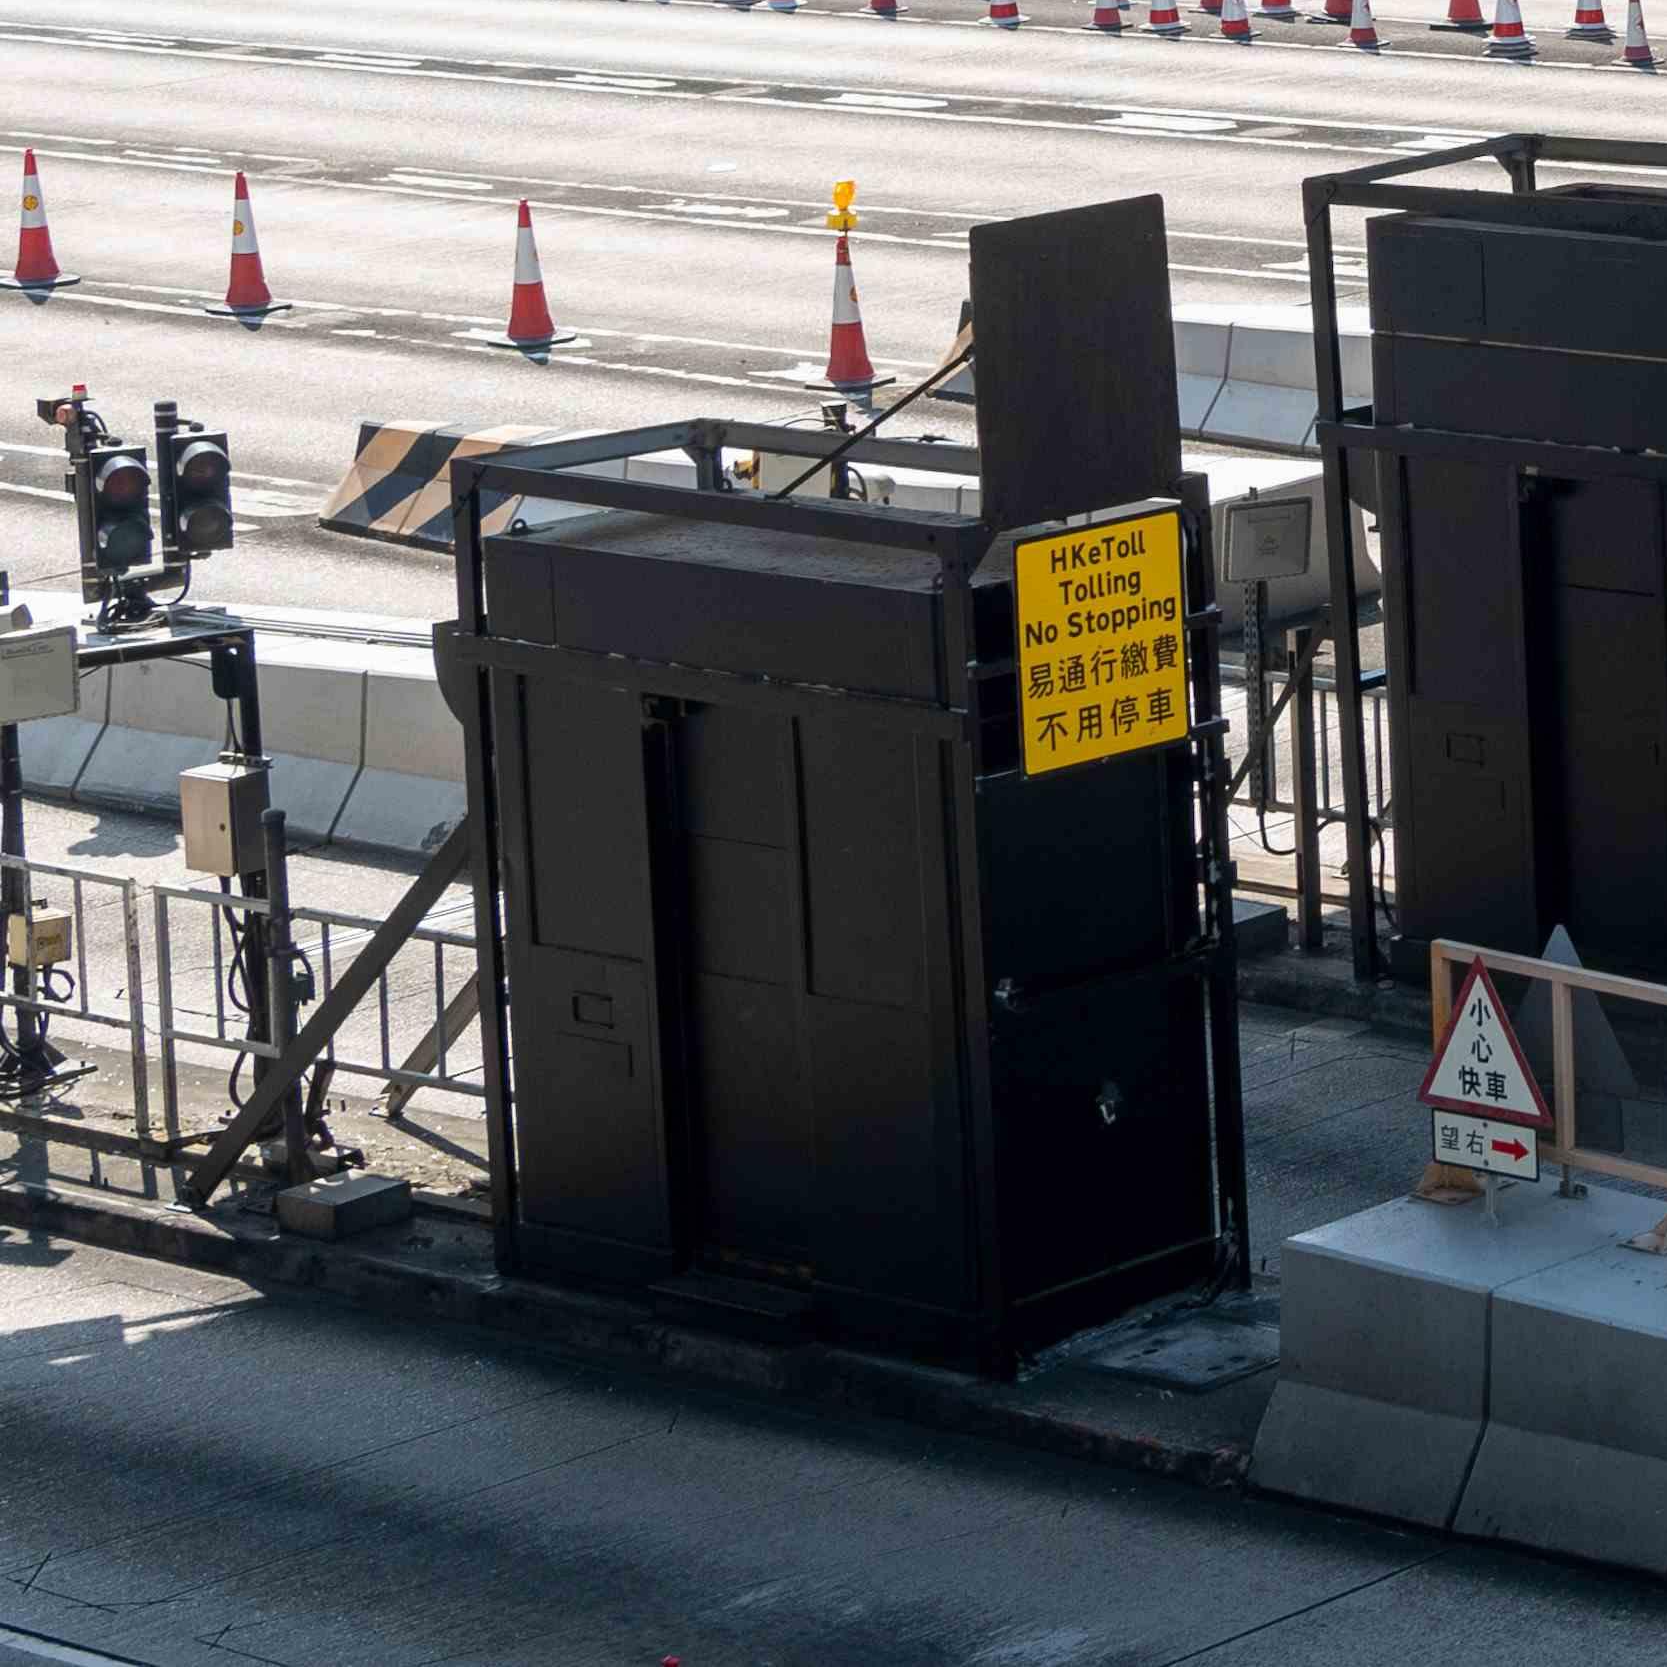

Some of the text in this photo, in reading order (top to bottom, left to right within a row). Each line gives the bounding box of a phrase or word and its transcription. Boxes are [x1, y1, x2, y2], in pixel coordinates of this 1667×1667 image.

[1051, 530, 1146, 574] HKeToll
[1059, 571, 1141, 605] Tolling
[1025, 596, 1176, 648] No Stopping
[1028, 634, 1178, 699] 易通行繳費
[1036, 687, 1175, 752] 不用停車
[1458, 1065, 1508, 1102] 快車
[1440, 1125, 1484, 1155] 望右
